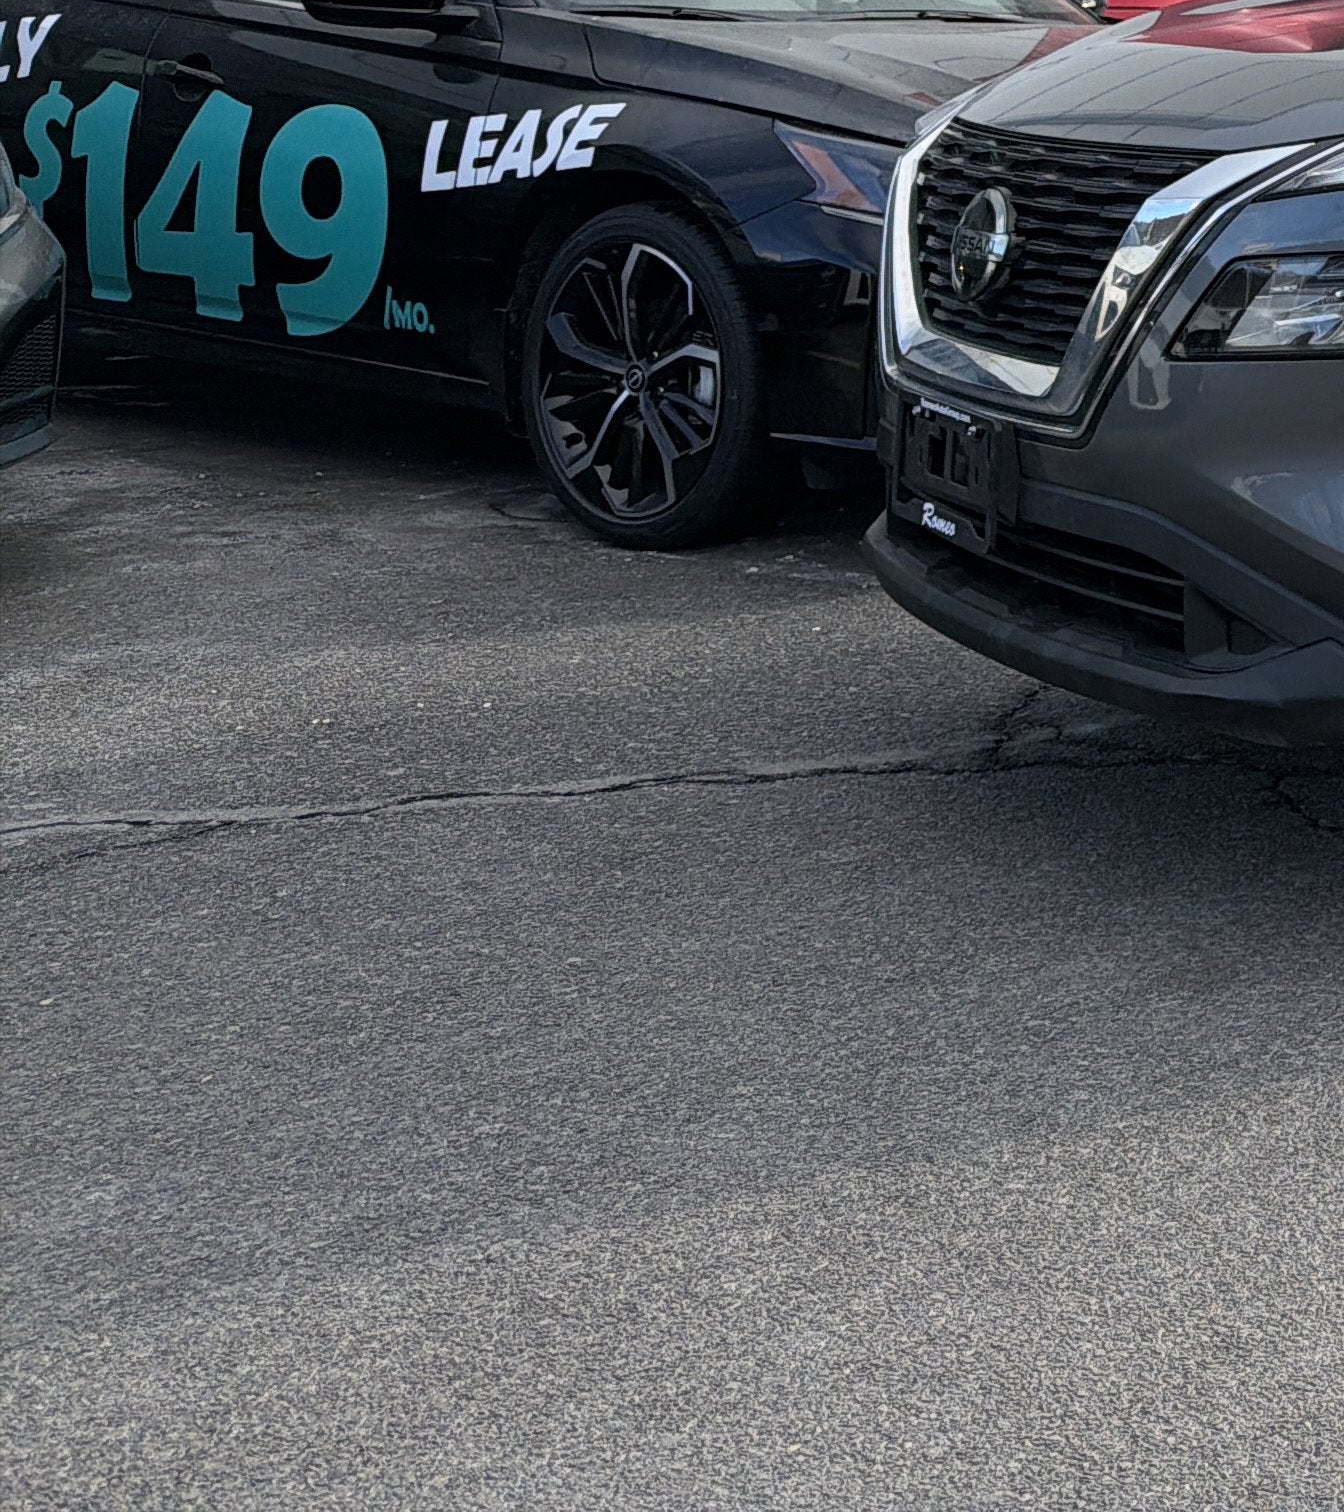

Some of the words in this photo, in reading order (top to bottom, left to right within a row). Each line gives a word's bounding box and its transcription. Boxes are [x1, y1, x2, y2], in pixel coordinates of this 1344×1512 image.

[421, 102, 627, 193] LEASE
[18, 80, 389, 337] $149
[384, 286, 435, 335] /MO.
[921, 502, 956, 536] Romeo
